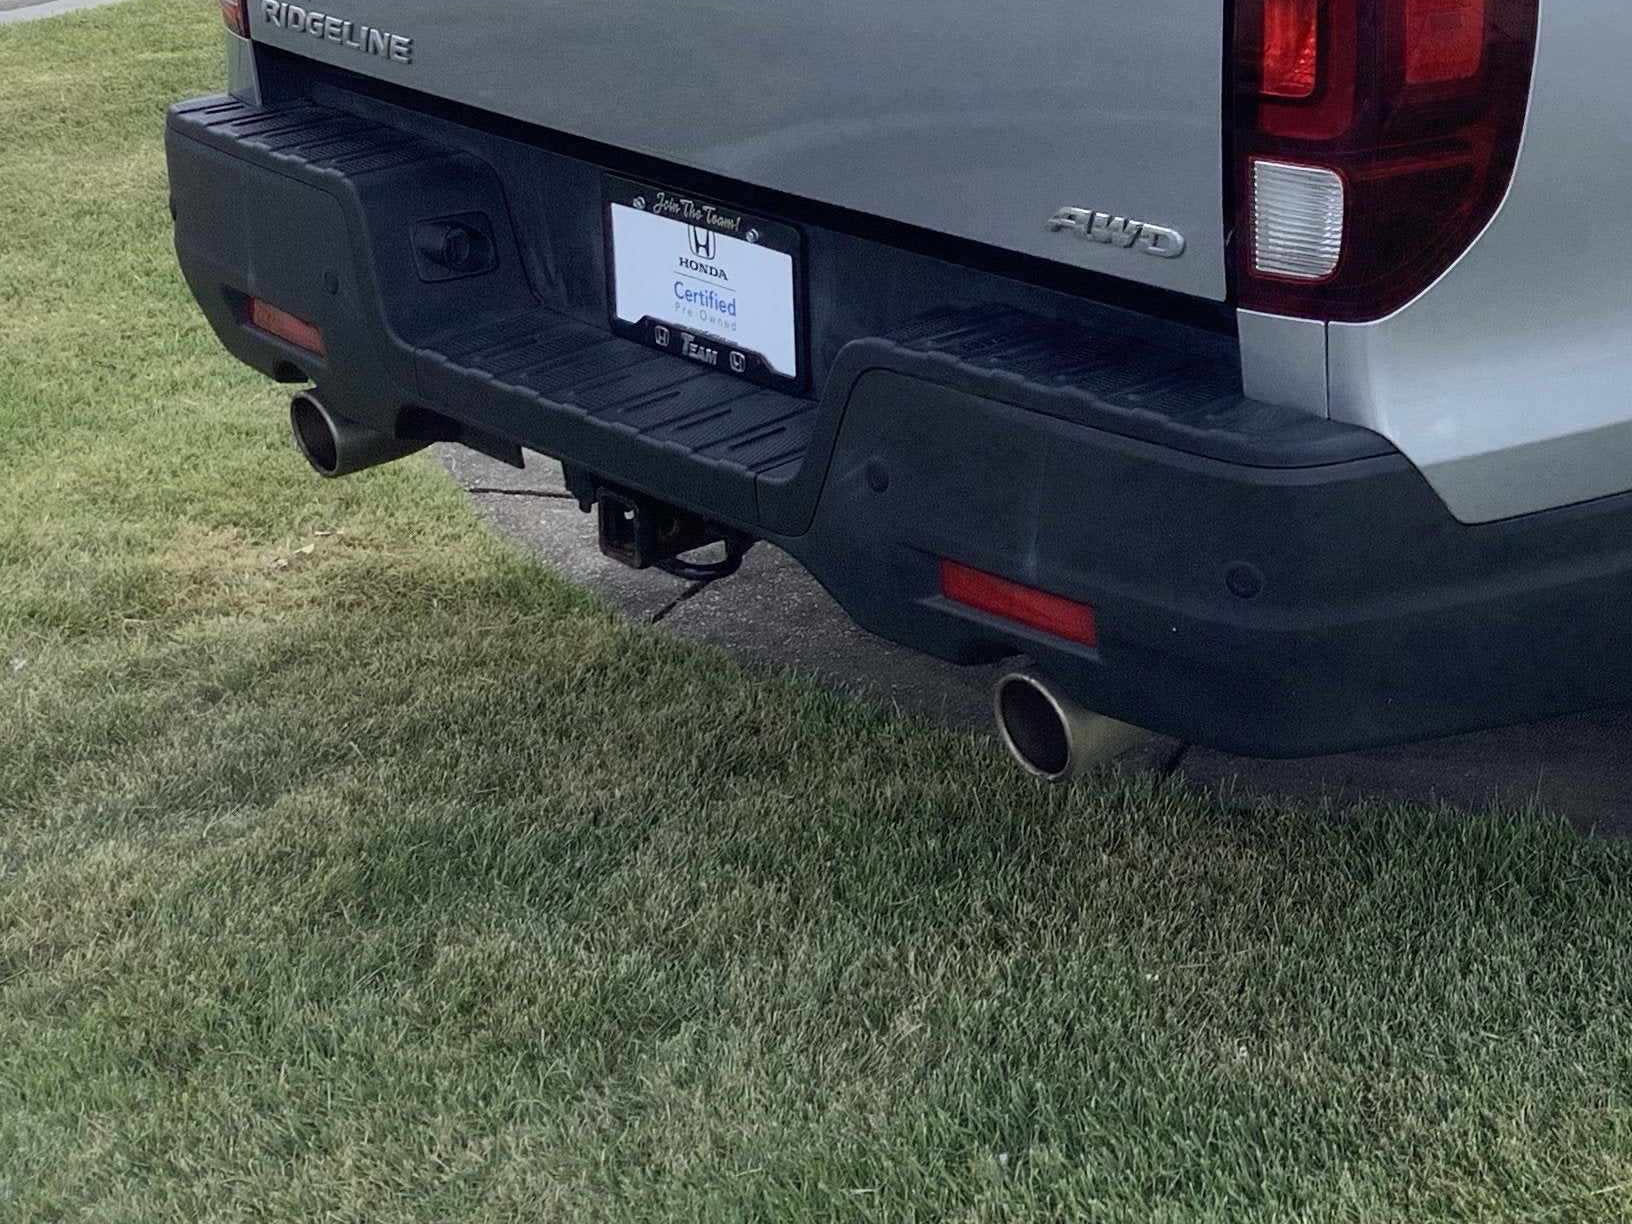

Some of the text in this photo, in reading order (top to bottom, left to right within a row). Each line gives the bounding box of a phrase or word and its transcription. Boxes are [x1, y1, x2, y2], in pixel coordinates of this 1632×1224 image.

[653, 192, 741, 232] Join The Team!
[1048, 206, 1187, 259] AWD
[678, 256, 729, 281] HONDA
[674, 281, 737, 317] Certified
